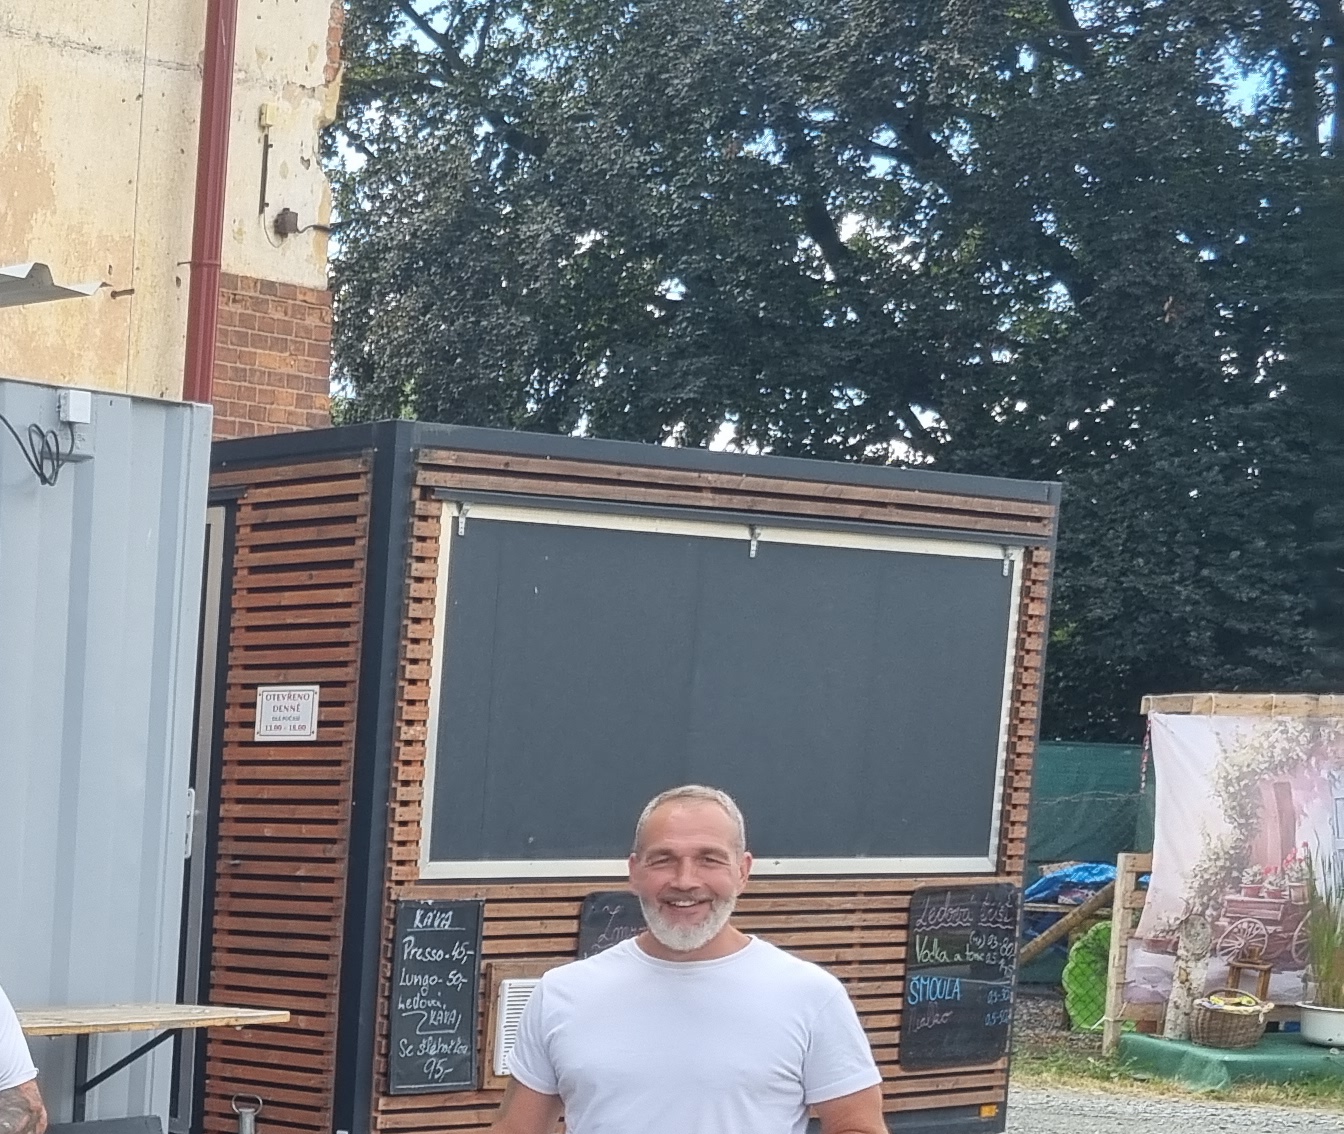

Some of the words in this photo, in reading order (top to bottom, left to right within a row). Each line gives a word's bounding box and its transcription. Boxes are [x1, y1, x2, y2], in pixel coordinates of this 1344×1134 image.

[265, 691, 310, 701] OTEVŘENO
[272, 703, 301, 712] DENNĚ
[413, 908, 454, 929] KÁVA
[907, 975, 961, 1005] ŠMOULA
